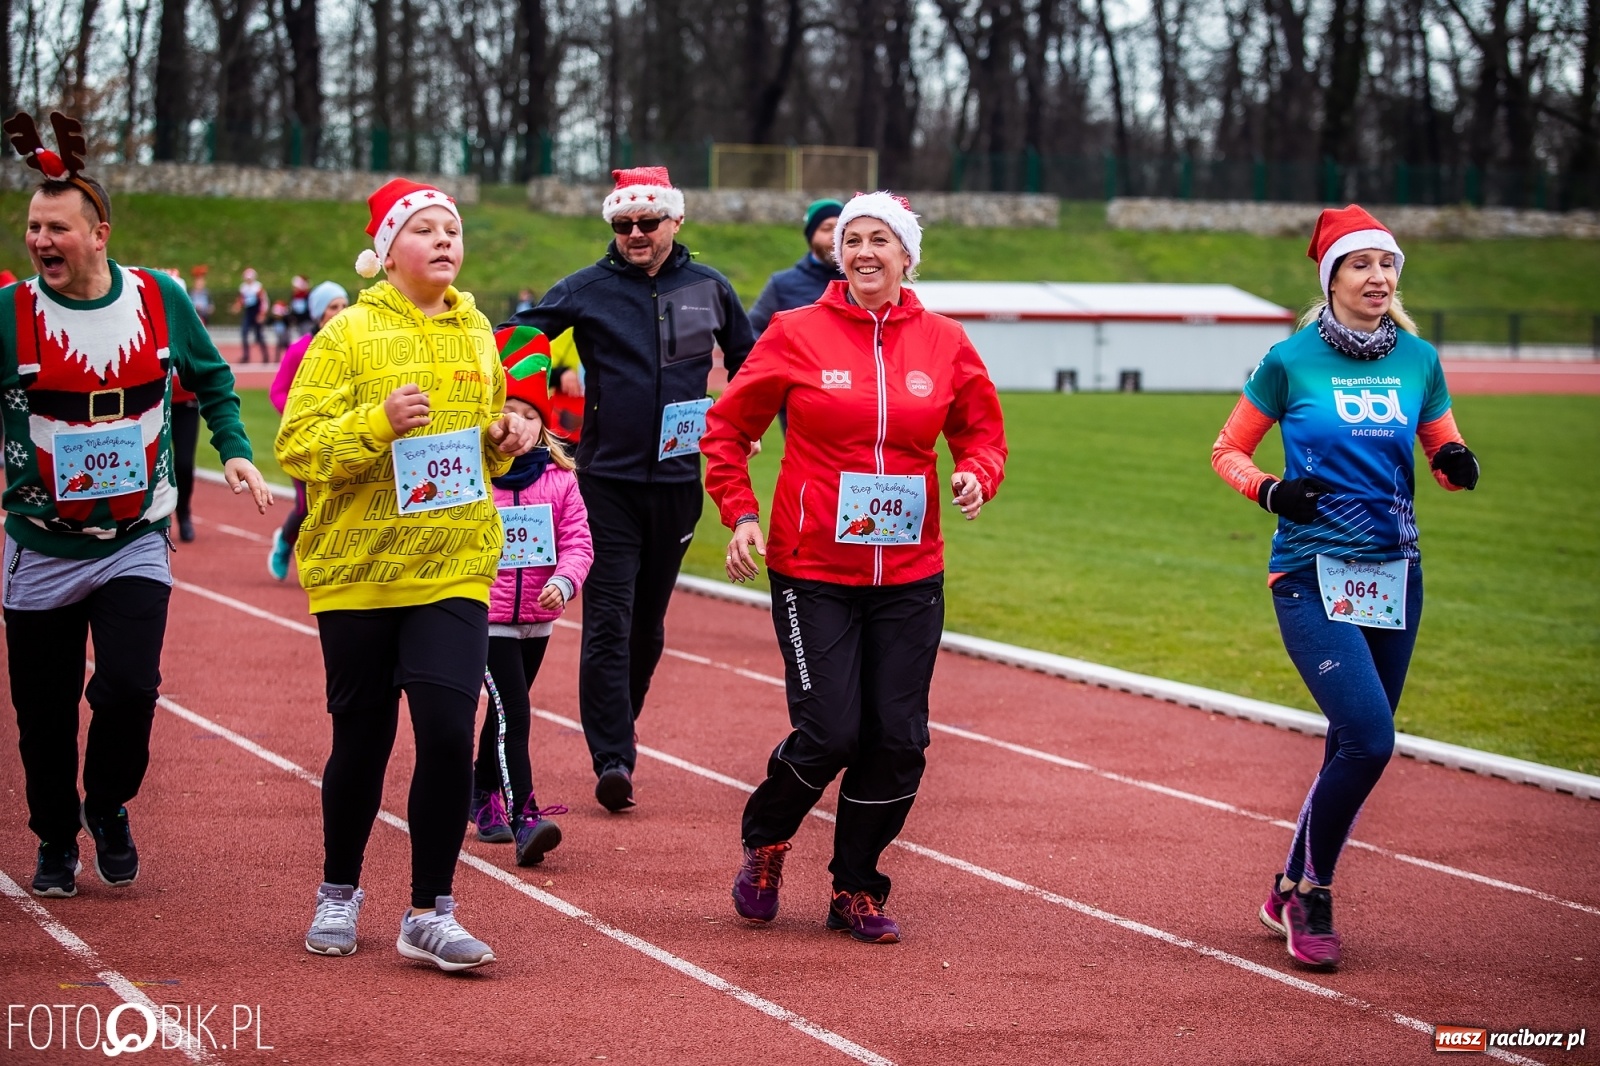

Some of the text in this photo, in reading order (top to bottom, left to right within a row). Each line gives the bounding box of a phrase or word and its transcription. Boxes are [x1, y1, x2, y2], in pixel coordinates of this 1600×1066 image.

[822, 369, 851, 384] bbl
[1332, 377, 1401, 387] BiegamBoLubię
[1333, 389, 1408, 425] bbl
[677, 420, 694, 435] 051
[1351, 428, 1395, 437] RACIBÓRZ
[84, 452, 120, 471] 002
[427, 457, 463, 478] 034
[869, 498, 903, 516] 048
[1345, 580, 1379, 599] 064
[782, 588, 812, 691] smsraciborz.pl
